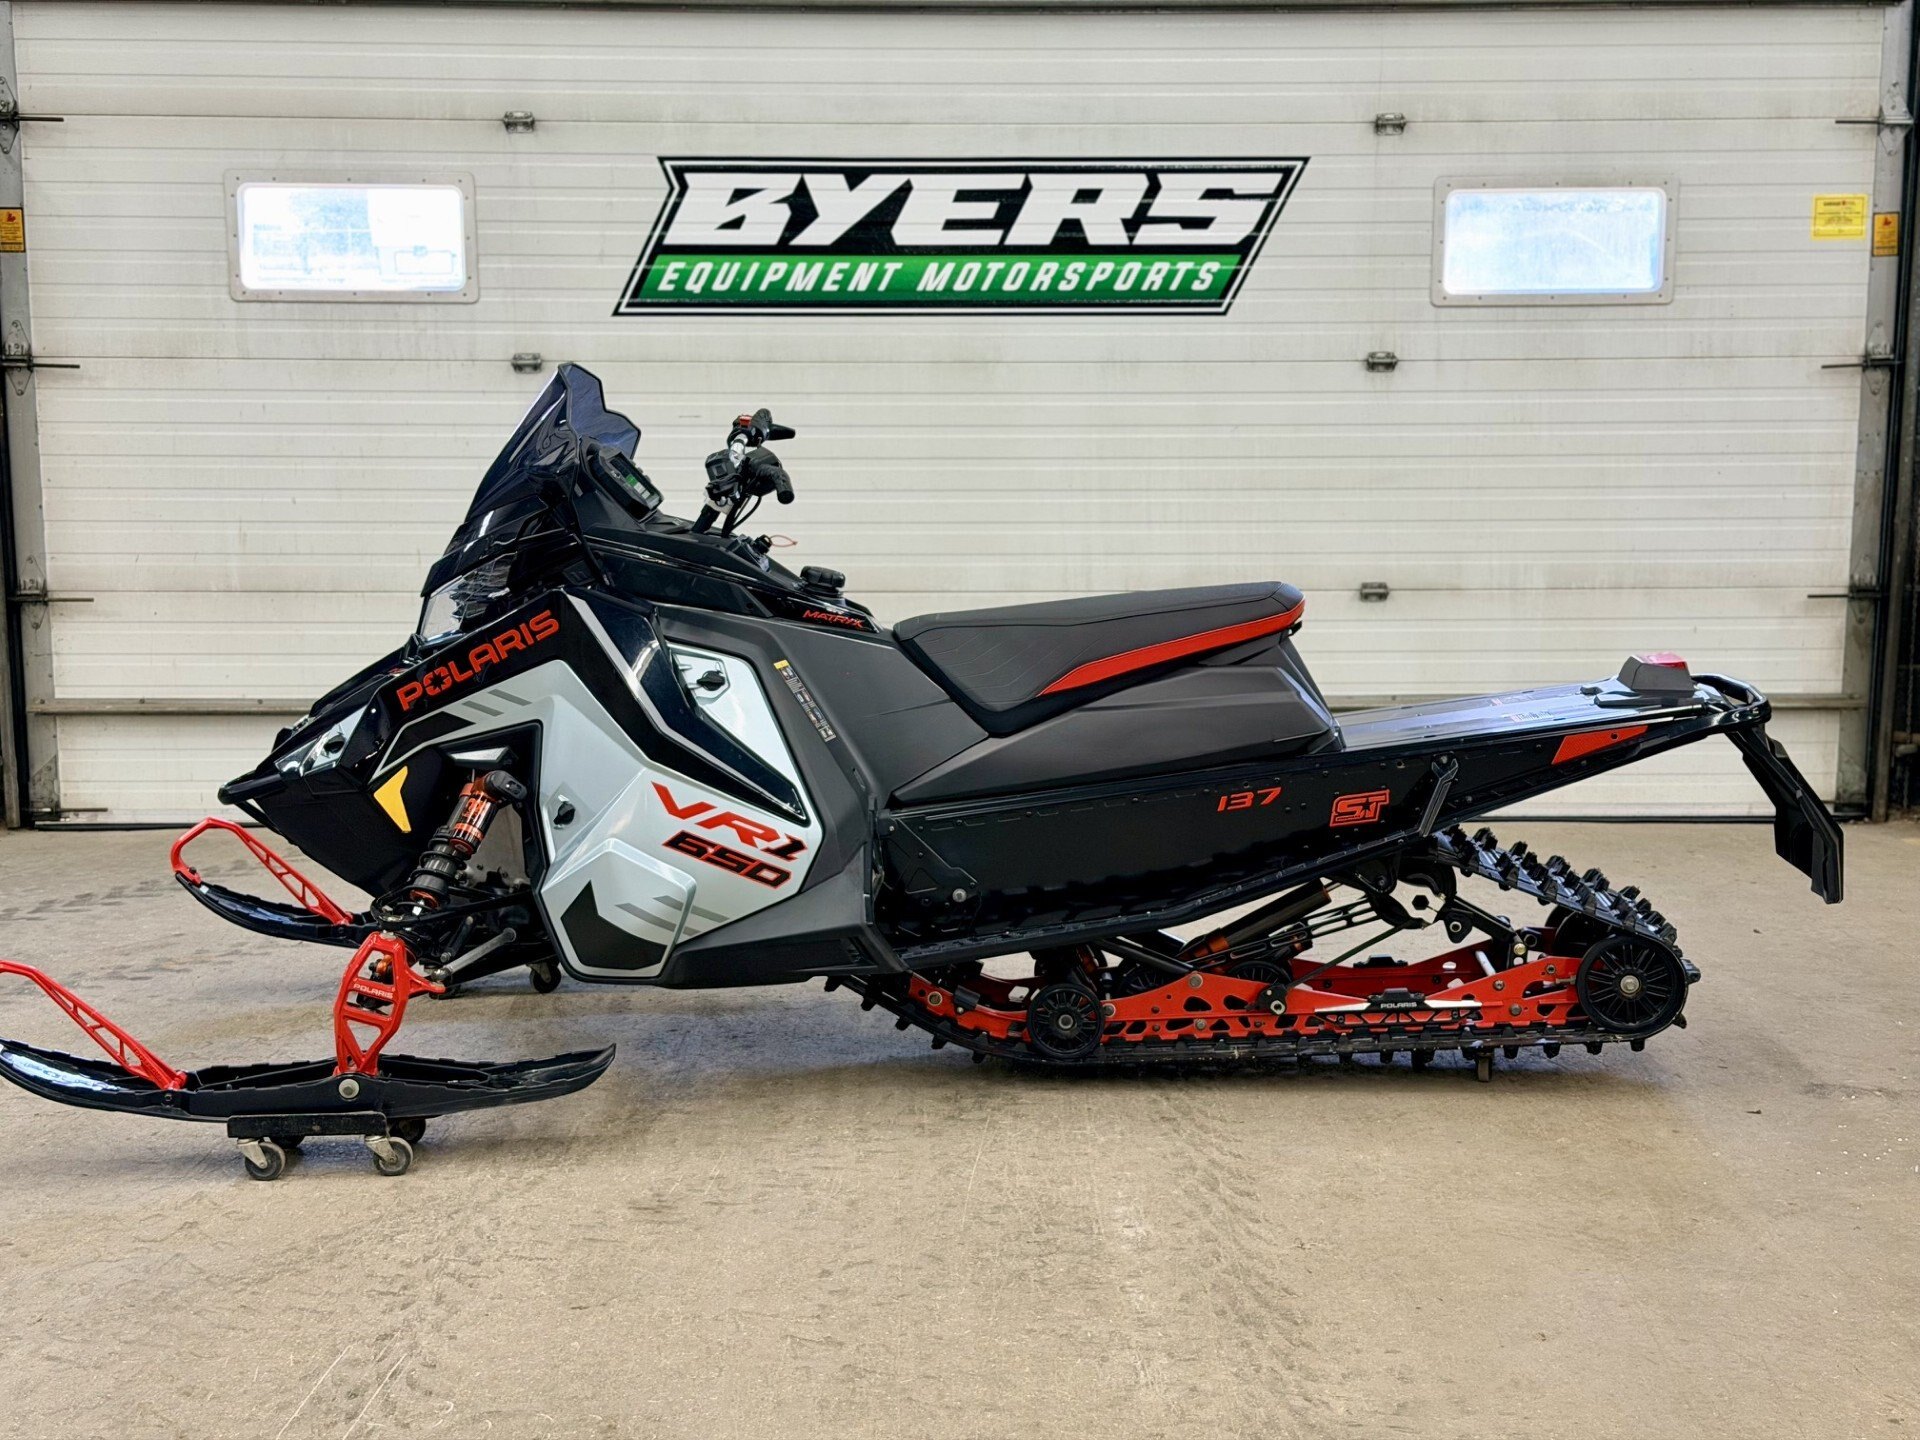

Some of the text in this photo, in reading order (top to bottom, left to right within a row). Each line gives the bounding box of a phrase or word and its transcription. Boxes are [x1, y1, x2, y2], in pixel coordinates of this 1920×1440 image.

[662, 173, 1284, 245] BYERS
[657, 262, 1221, 294] EQUIPMENT MOTORSPORTS
[803, 609, 864, 628] MATRYX
[396, 609, 560, 712] POLARIS
[1217, 787, 1282, 813] 137
[1331, 790, 1389, 826] ST
[651, 780, 808, 862] VR1
[662, 829, 792, 890] 650
[353, 983, 394, 999] POLARIS
[1380, 1001, 1418, 1009] POLARIS
